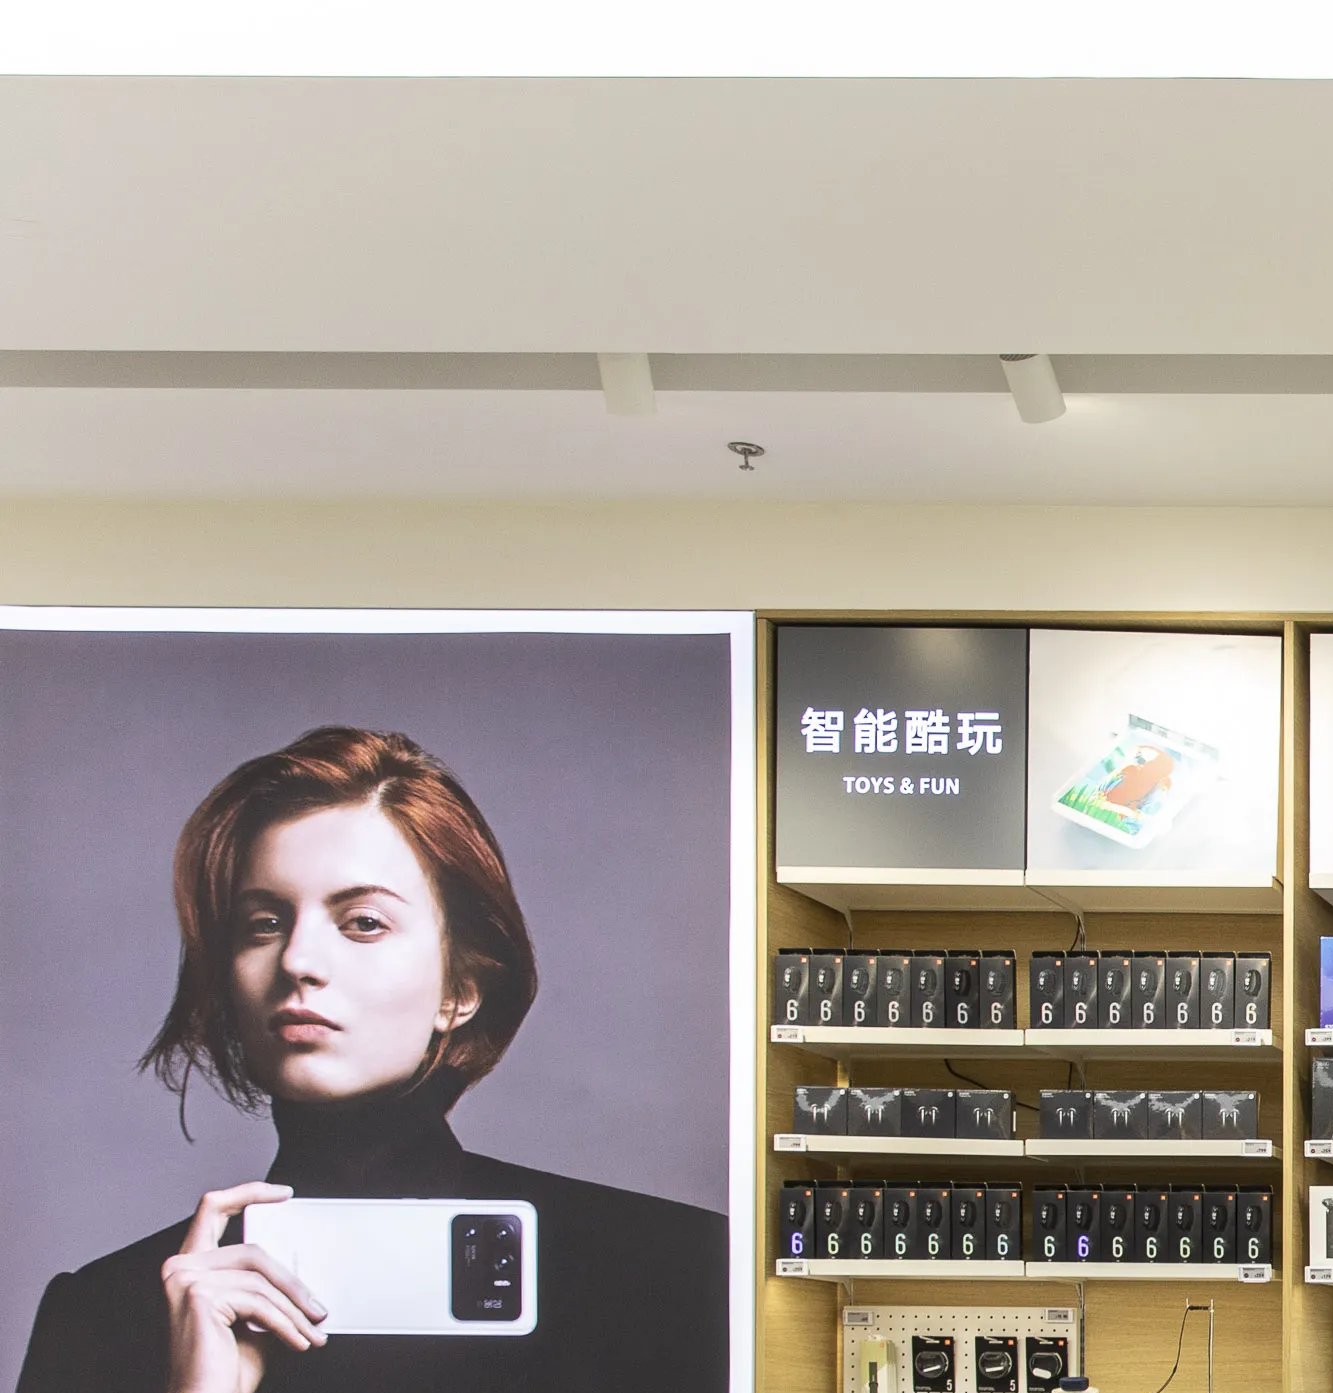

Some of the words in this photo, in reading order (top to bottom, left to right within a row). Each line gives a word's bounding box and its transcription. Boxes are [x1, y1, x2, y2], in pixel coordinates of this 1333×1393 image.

[800, 706, 1003, 757] 智能酷玩
[843, 776, 894, 795] TOYS
[900, 776, 914, 795] &
[919, 777, 960, 795] FUN
[787, 1001, 798, 1021] 6
[820, 1001, 831, 1022] 6
[854, 1001, 865, 1022] 6
[888, 1001, 899, 1022] 6
[922, 1002, 933, 1022] 6
[957, 1003, 968, 1023] 6
[991, 1002, 1003, 1023] 6
[1041, 1003, 1052, 1023] 6
[1075, 1002, 1087, 1023] 6
[1109, 1003, 1121, 1023] 6
[1143, 1003, 1155, 1023] 6
[1177, 1003, 1188, 1023] 6
[1211, 1003, 1223, 1023] 6
[1245, 1003, 1257, 1024] 6
[791, 1233, 803, 1254] 6
[827, 1233, 839, 1254] 6
[860, 1233, 872, 1254] 6
[895, 1234, 906, 1254] 6
[928, 1234, 939, 1254] 6
[962, 1234, 974, 1254] 6
[997, 1234, 1009, 1255] 6
[1044, 1236, 1055, 1257] 6
[1077, 1236, 1089, 1257] 6
[1112, 1237, 1123, 1257] 6
[1146, 1237, 1157, 1258] 6
[1179, 1237, 1191, 1258] 6
[1213, 1238, 1225, 1258] 6
[1248, 1238, 1259, 1258] 6
